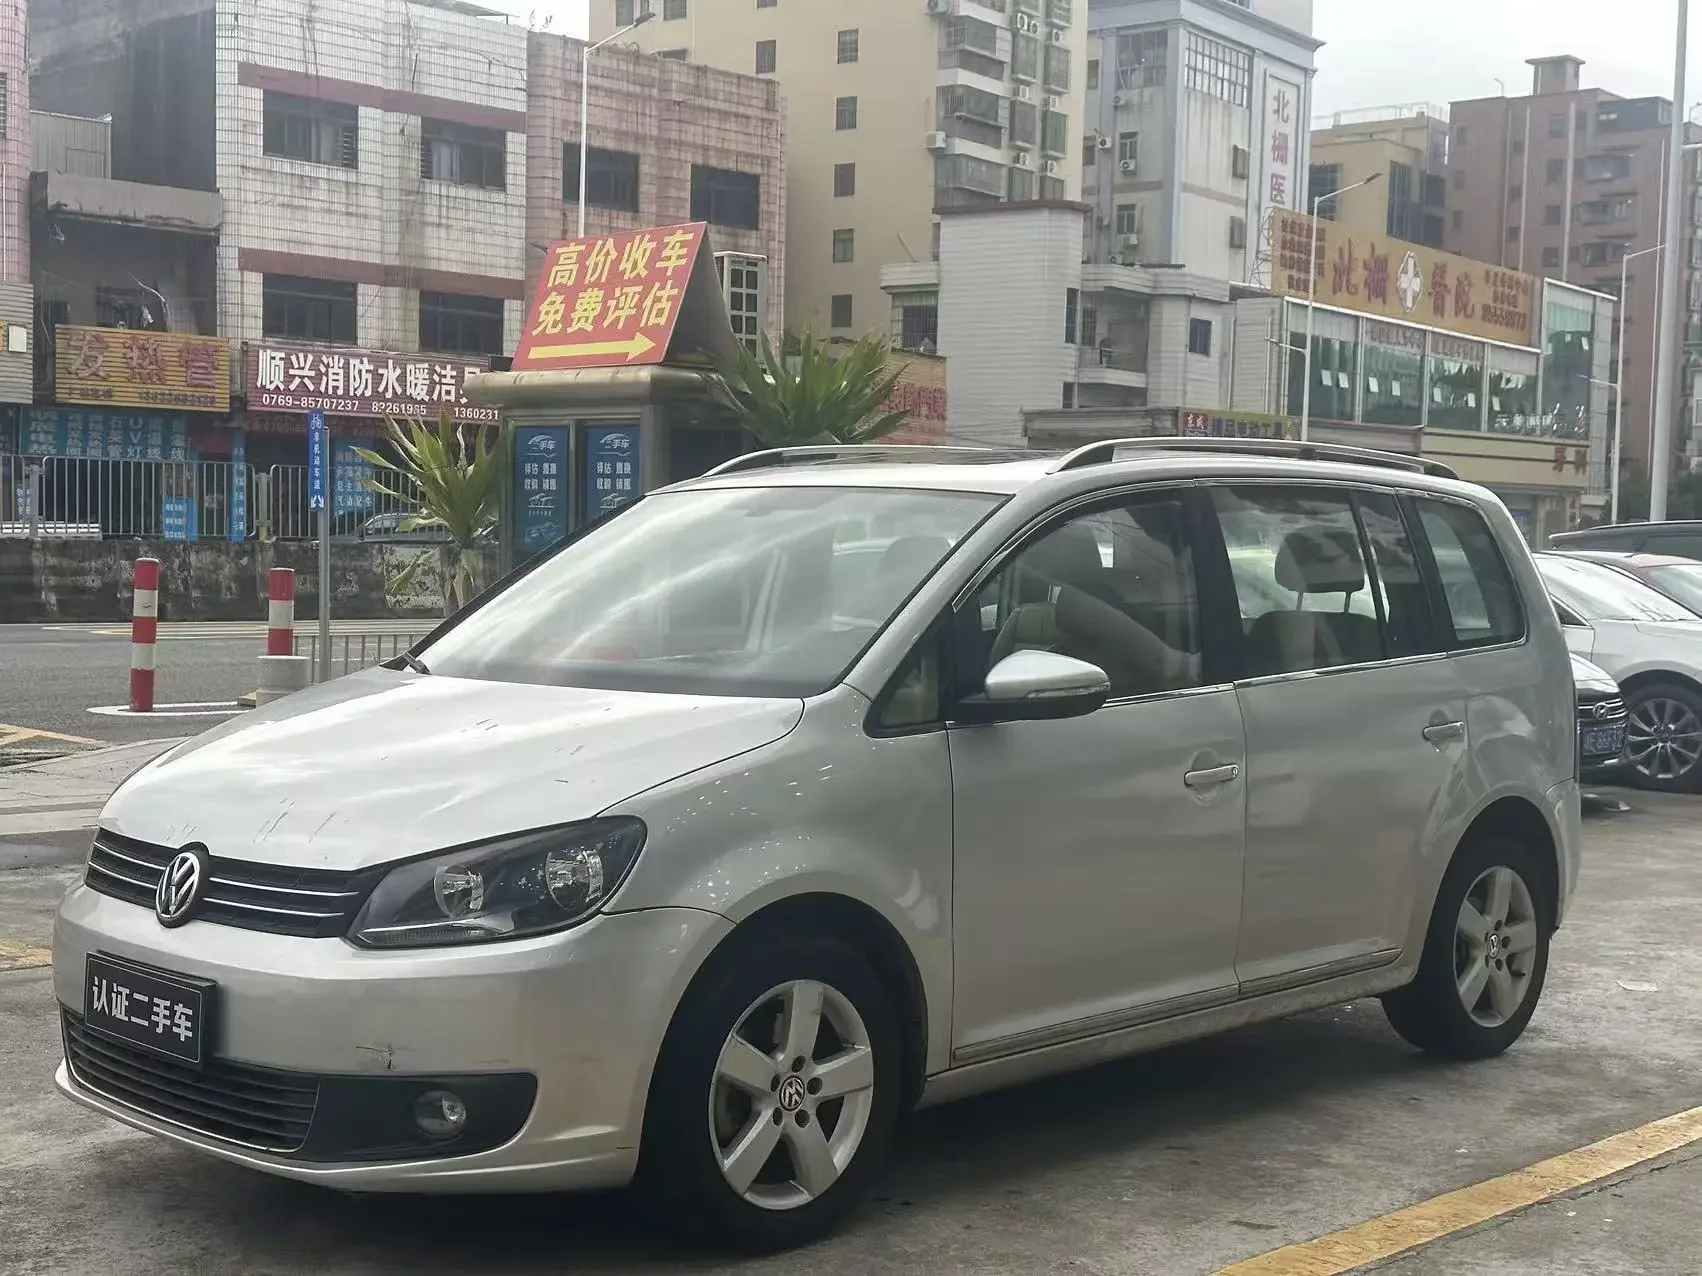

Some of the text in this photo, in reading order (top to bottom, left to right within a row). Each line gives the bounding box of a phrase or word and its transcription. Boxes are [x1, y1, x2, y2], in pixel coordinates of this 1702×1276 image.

[547, 229, 694, 288] 高价收车
[531, 280, 679, 337] 免费评估
[262, 393, 359, 412] 0769-85707237
[604, 439, 630, 449] 二手车
[596, 461, 612, 475] 评估
[92, 975, 193, 1042] 认证二手车
